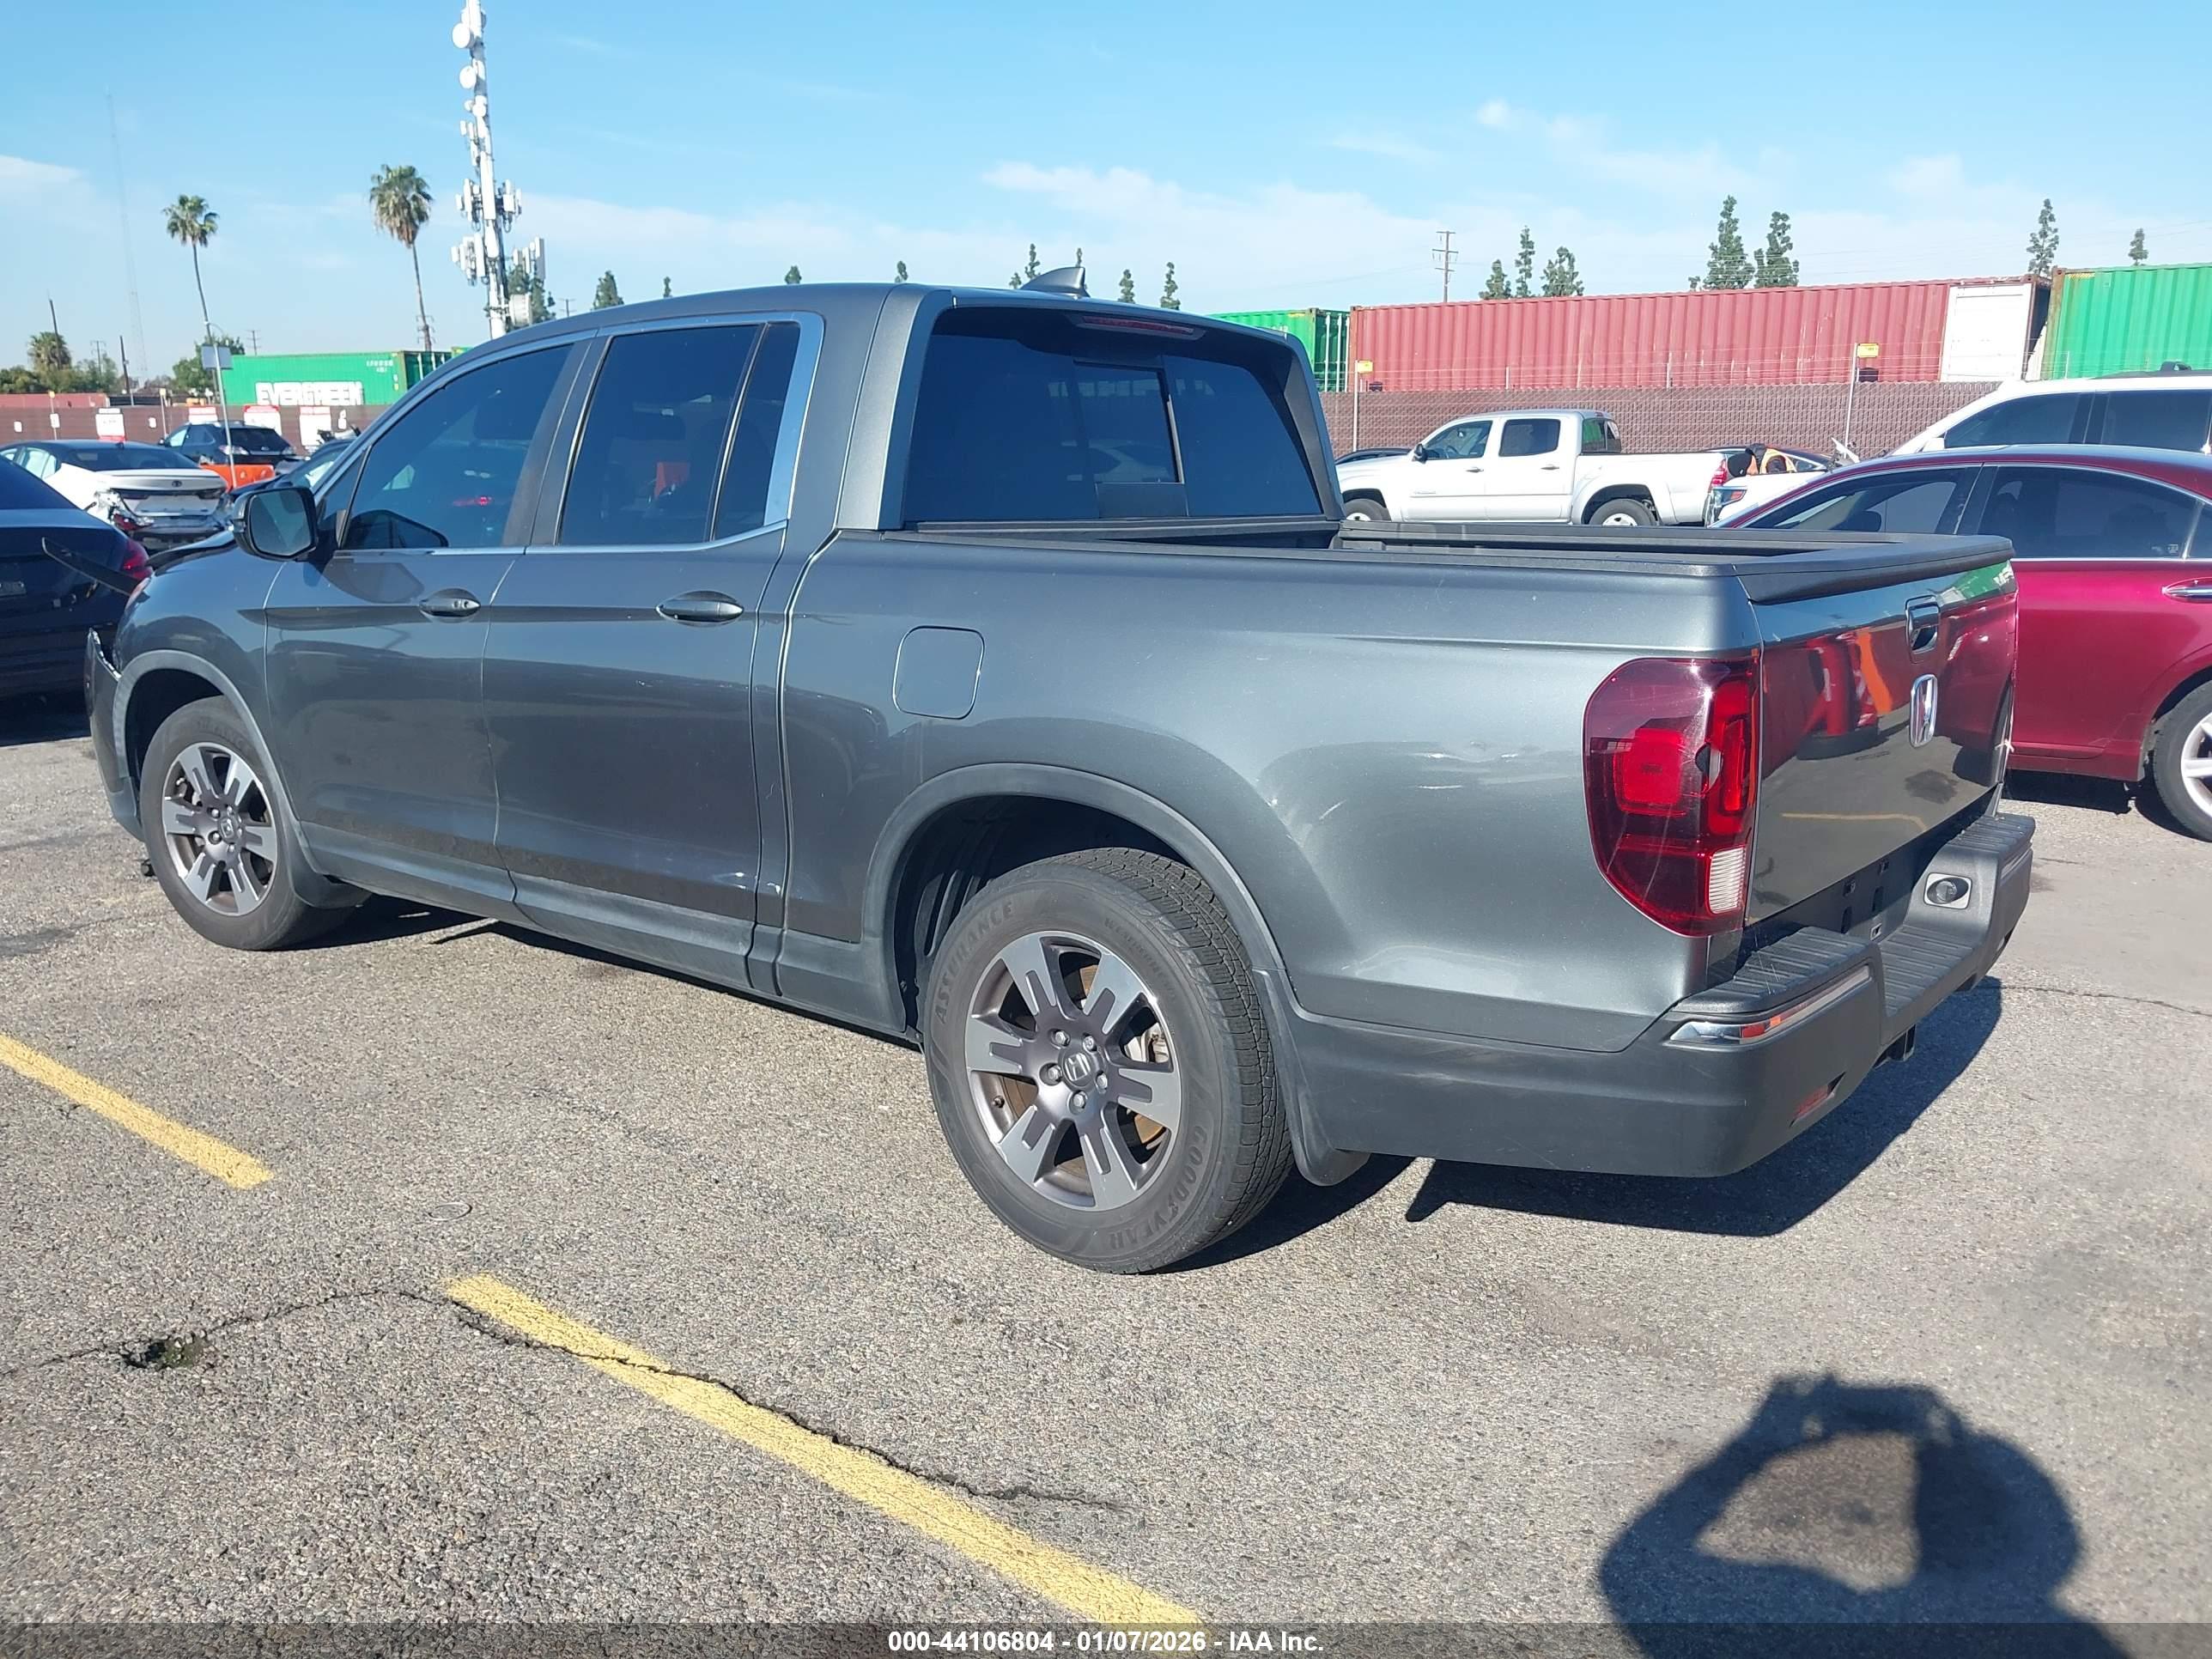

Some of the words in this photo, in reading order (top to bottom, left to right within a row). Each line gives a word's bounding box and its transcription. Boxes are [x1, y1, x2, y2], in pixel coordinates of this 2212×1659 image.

[255, 381, 364, 405] EVERGREEN
[934, 902, 1014, 1025] ASSURANCE
[1109, 1125, 1208, 1250] GOODYEAR
